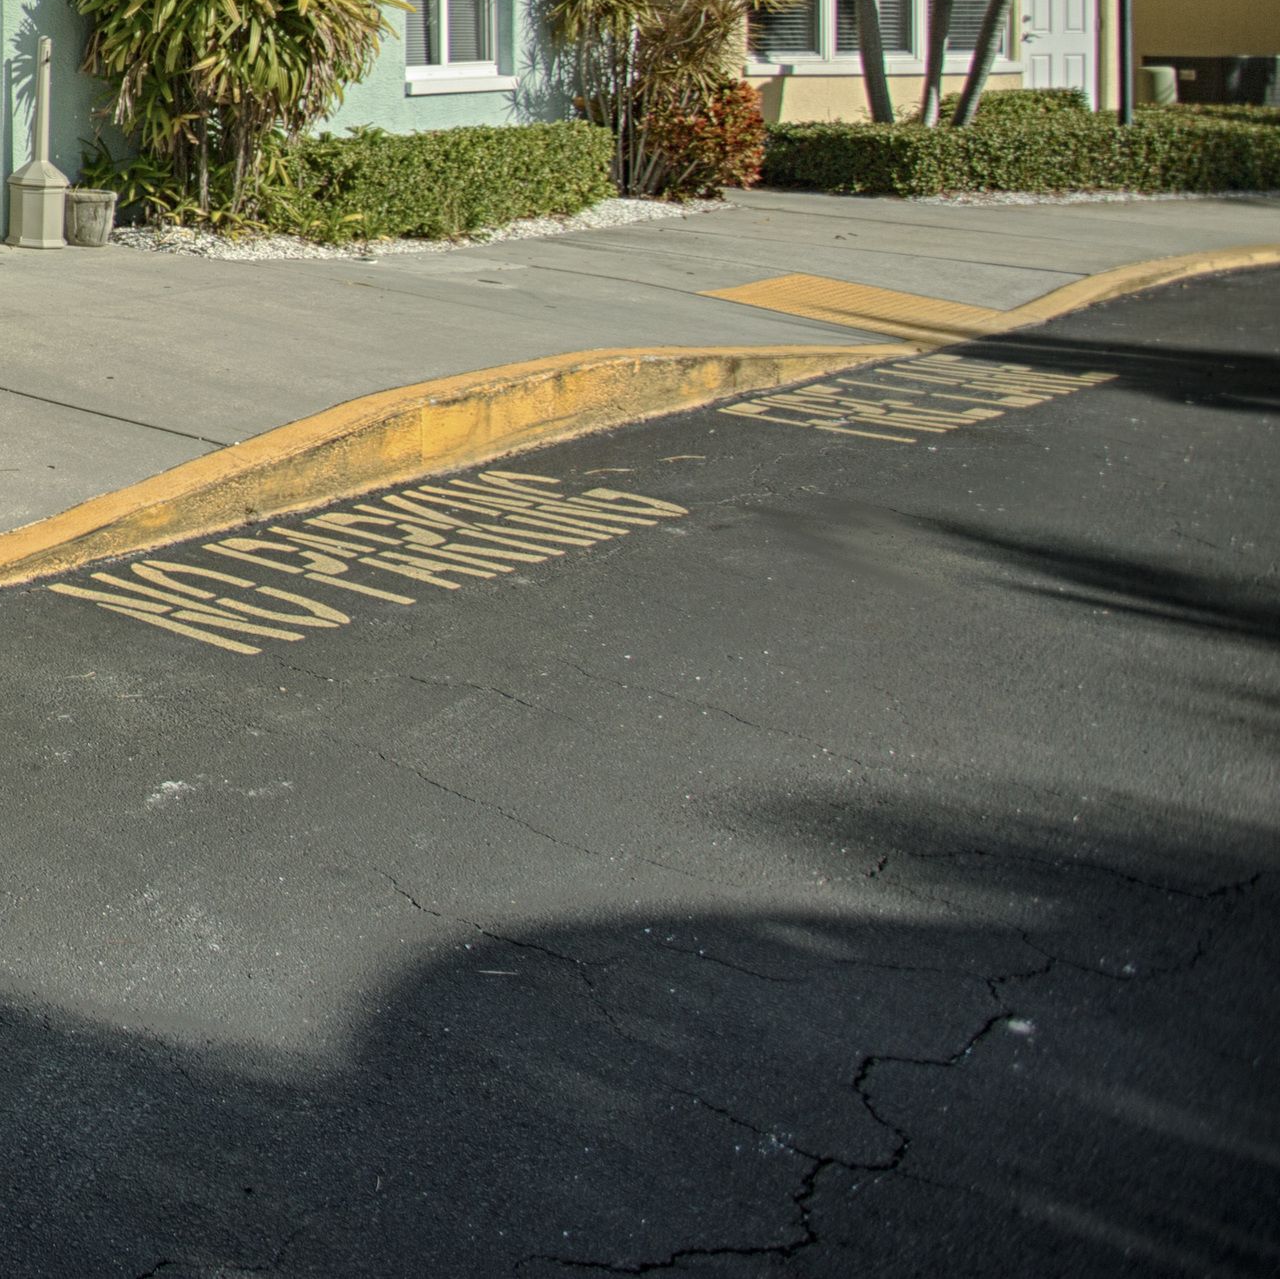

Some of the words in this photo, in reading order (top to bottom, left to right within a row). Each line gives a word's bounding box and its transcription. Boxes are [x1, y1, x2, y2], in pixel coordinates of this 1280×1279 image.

[836, 353, 1120, 407] LANE
[717, 384, 1005, 443] FIRE
[48, 558, 351, 655] NO
[202, 469, 690, 605] PARKING
